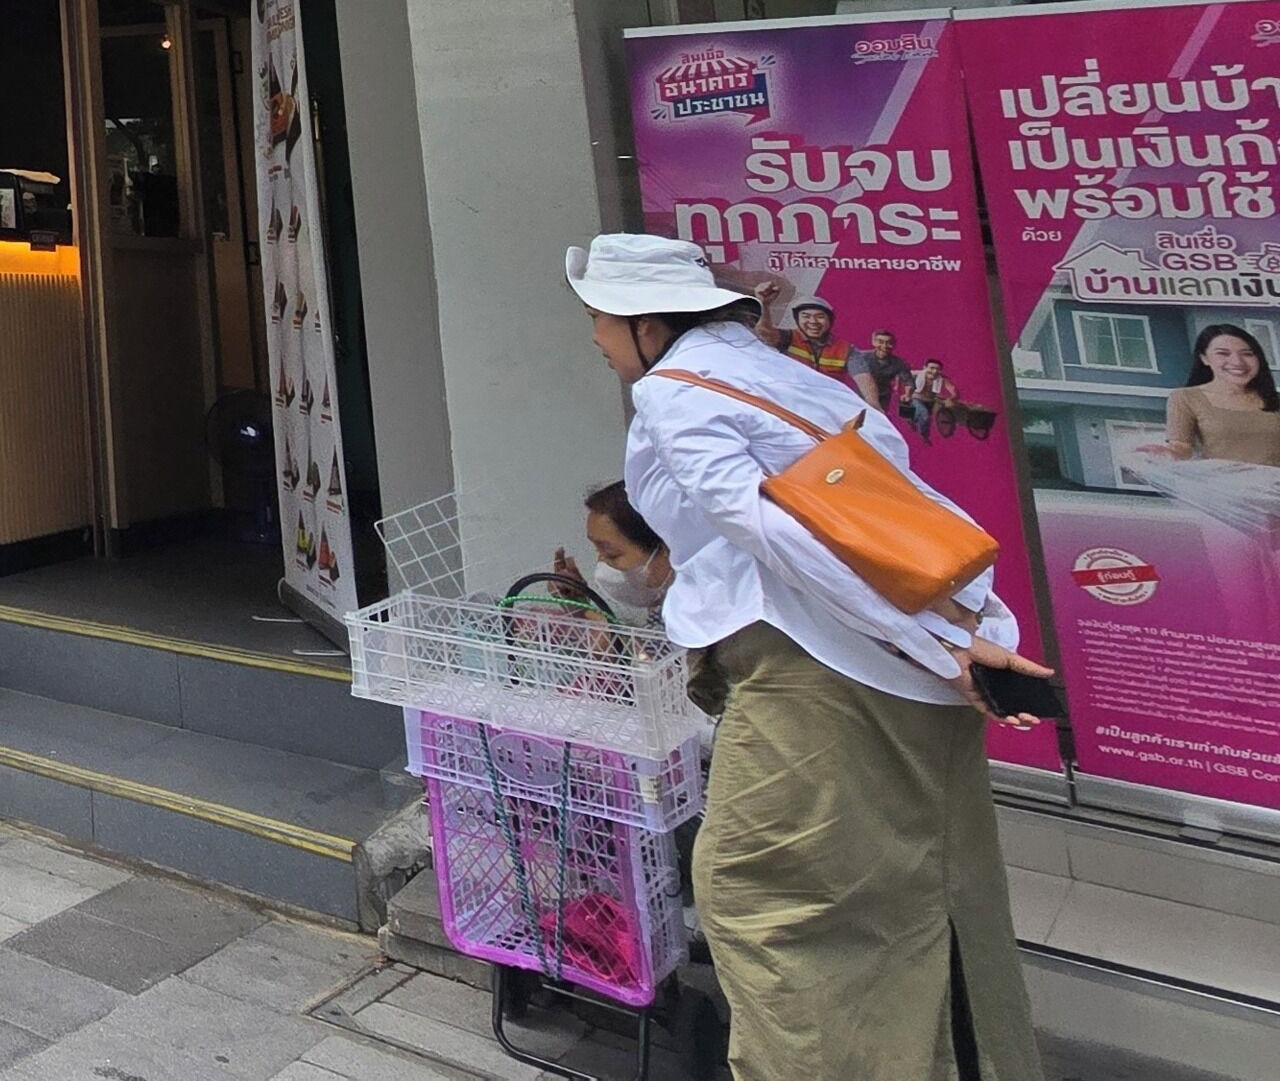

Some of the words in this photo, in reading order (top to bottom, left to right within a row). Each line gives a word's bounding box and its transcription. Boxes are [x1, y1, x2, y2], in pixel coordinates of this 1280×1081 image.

[854, 33, 934, 55] ออมสิน
[663, 70, 749, 98] ธนาคาร
[676, 91, 766, 116] ประชาชน
[1008, 119, 1280, 171] เป็นเงินก้
[744, 137, 952, 193] รับจบ
[1014, 171, 1275, 221] พร้อมใช้
[673, 197, 962, 263] ทุกภาระ
[1021, 227, 1063, 242] ด้วย
[1156, 226, 1234, 251] สินเชื่อ
[766, 251, 962, 273] กู้ได้หลากหลายอาชีพ
[1162, 252, 1238, 272] GSB
[1143, 626, 1158, 636] 10
[1097, 744, 1204, 770] www.gsb.or.th
[1213, 762, 1249, 778] GSB
